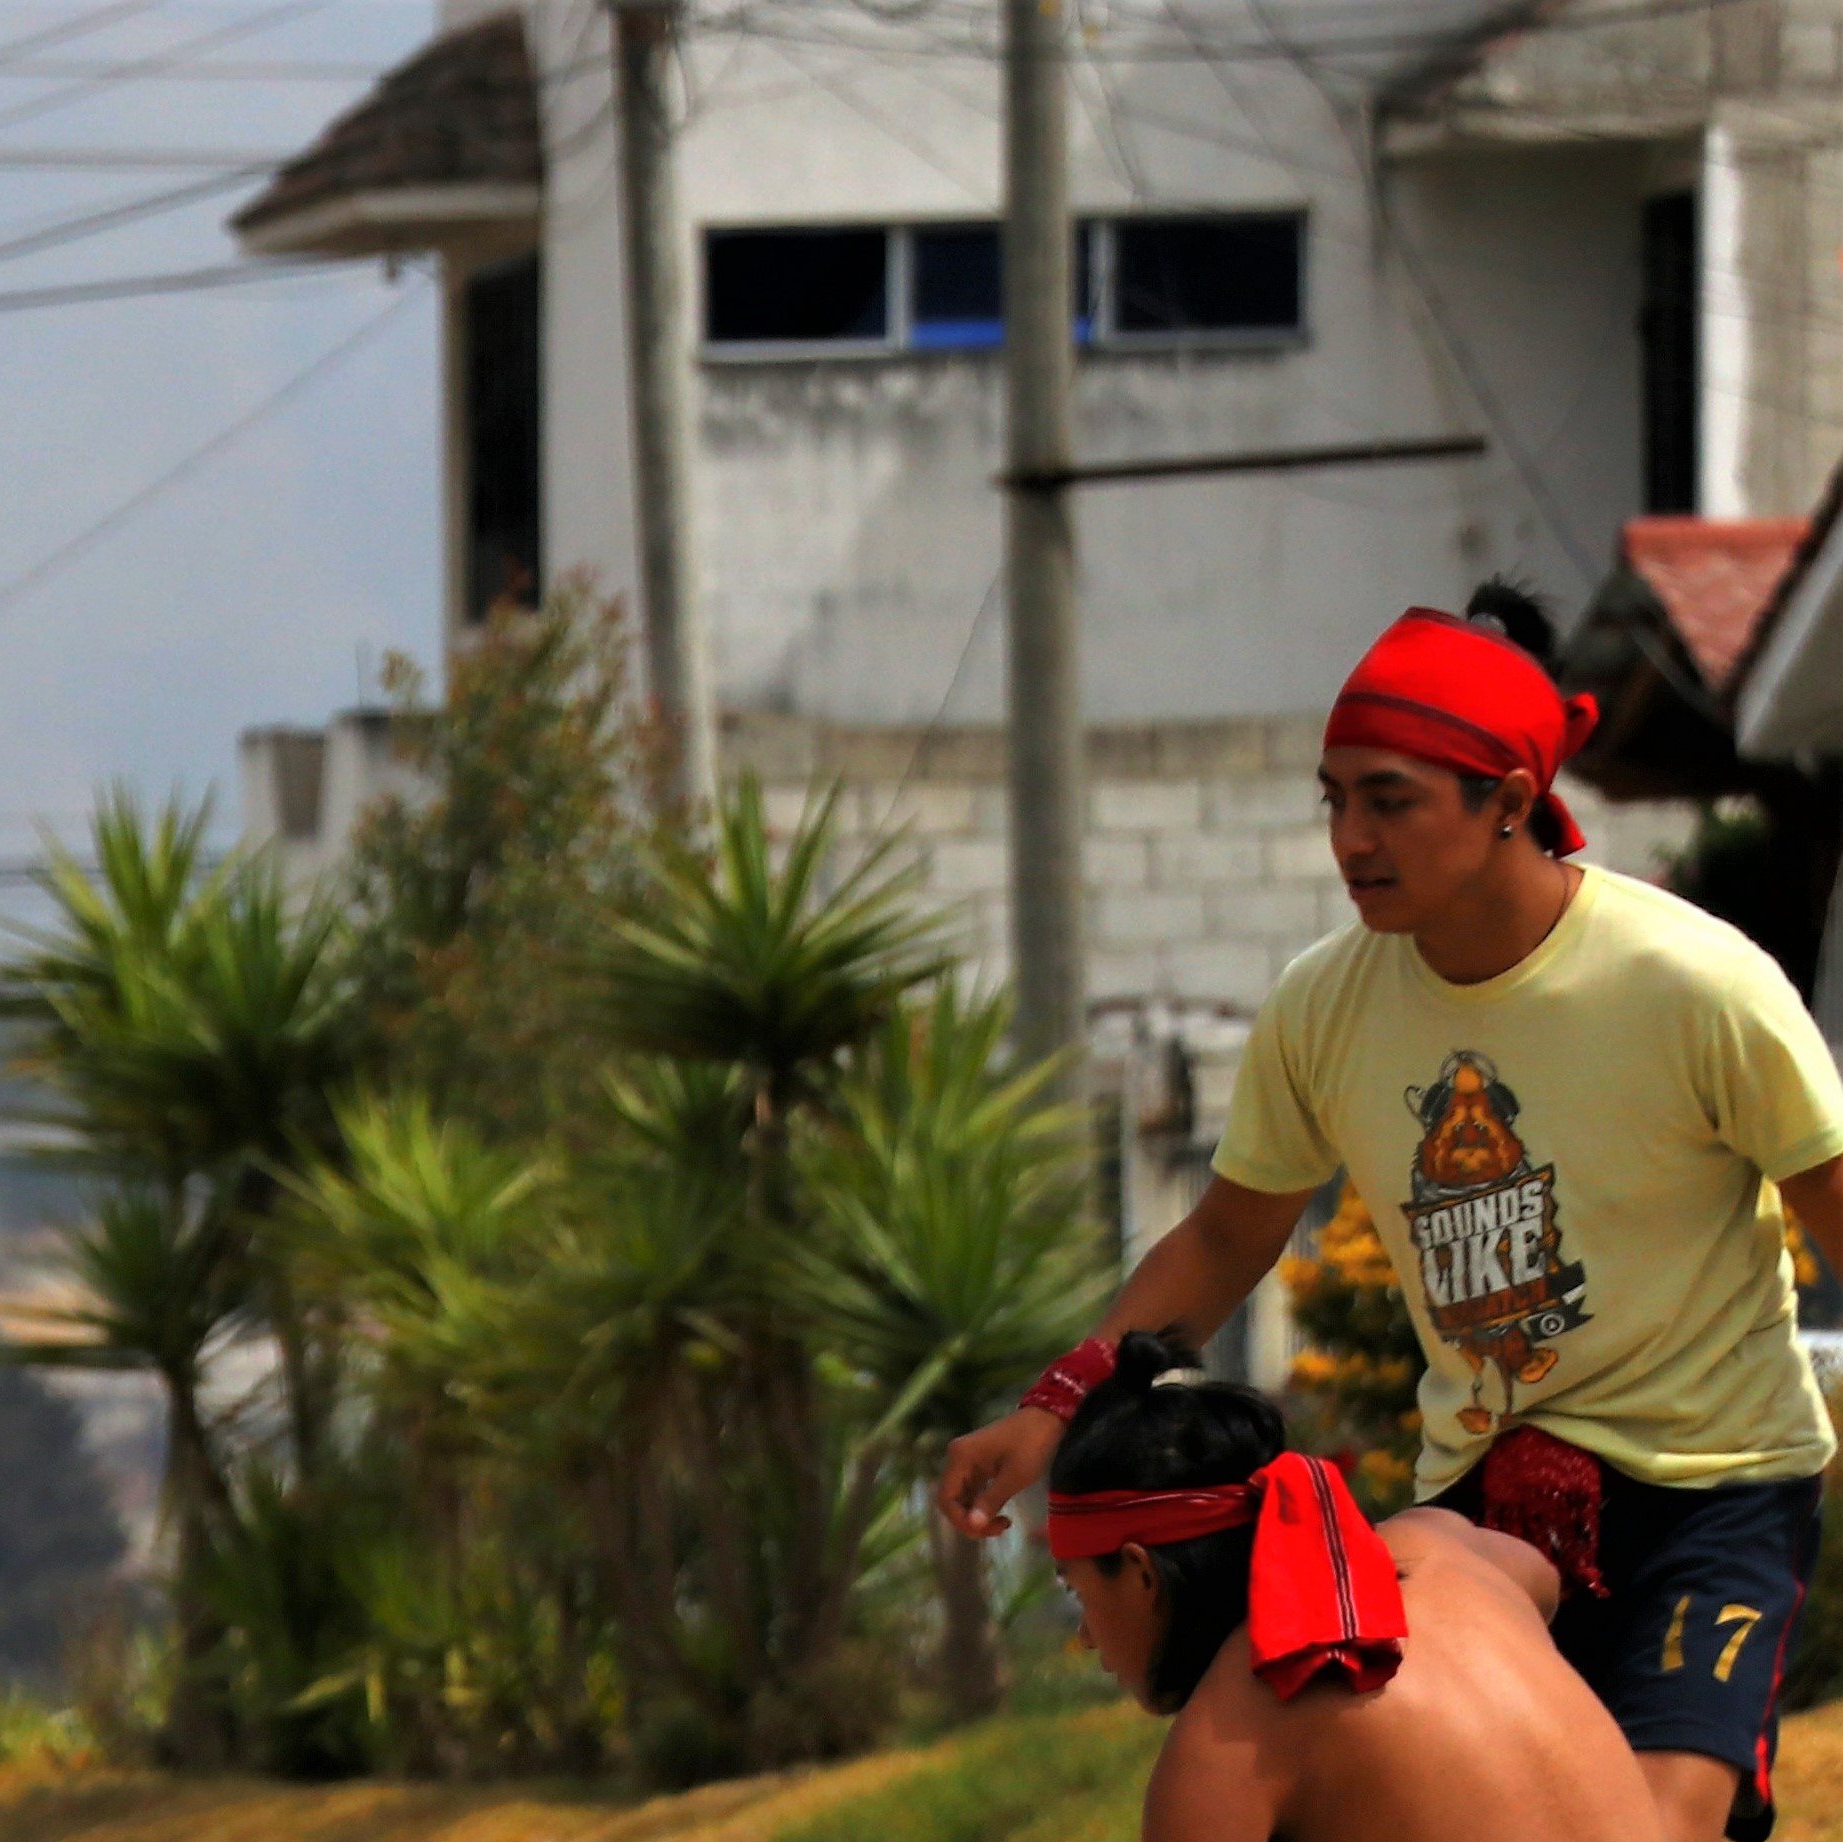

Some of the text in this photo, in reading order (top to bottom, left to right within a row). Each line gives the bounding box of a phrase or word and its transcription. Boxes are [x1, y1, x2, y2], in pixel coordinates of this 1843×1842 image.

[1415, 1179, 1545, 1250] SOUNDS
[1423, 1216, 1547, 1309] LIKE
[1661, 1593, 1763, 1683] 17
